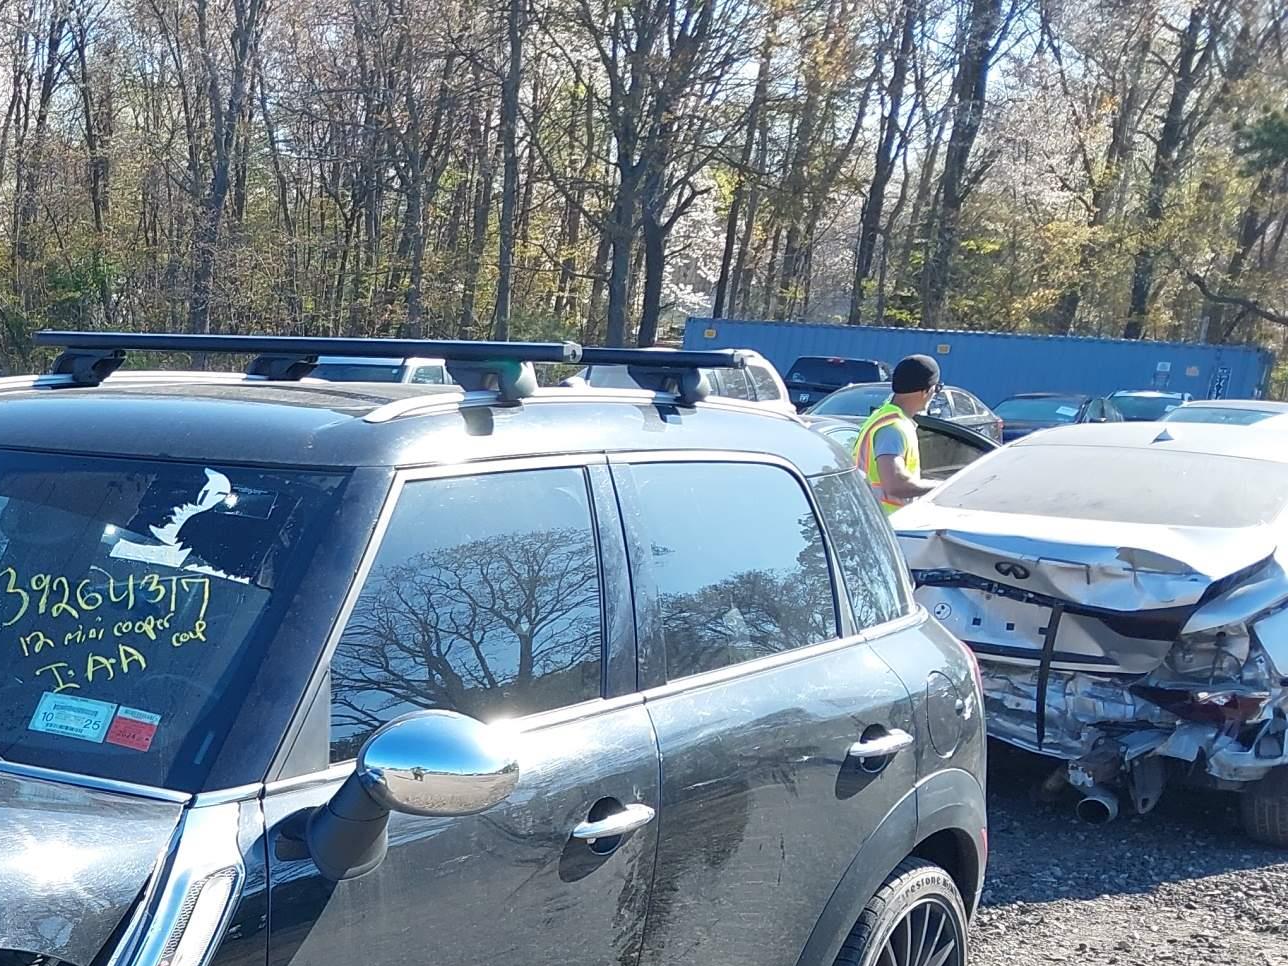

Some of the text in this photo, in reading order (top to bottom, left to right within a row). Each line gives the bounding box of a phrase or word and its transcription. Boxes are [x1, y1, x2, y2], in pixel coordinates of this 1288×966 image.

[20, 631, 55, 657] 12
[113, 614, 175, 641] cooper
[41, 711, 54, 723] 10
[83, 719, 102, 731] 25
